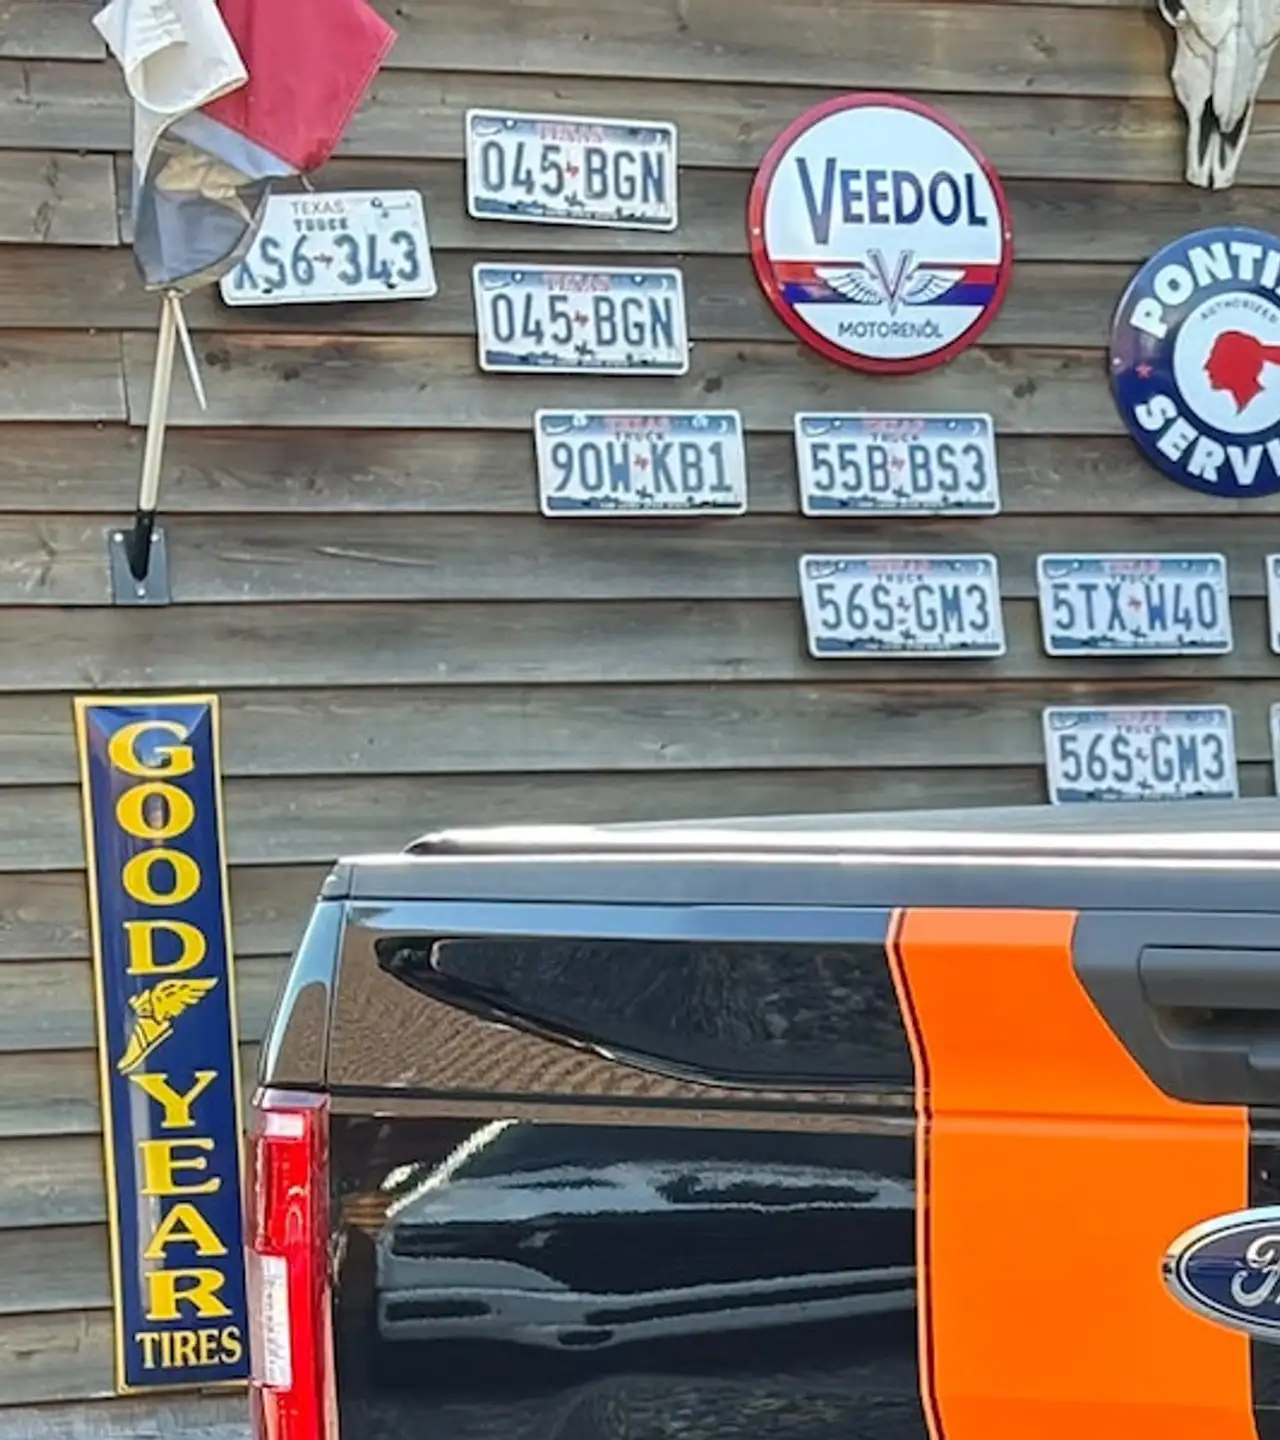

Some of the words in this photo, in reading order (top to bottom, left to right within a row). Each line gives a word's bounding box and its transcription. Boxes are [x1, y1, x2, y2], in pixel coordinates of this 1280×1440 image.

[291, 201, 344, 215] TEXAS
[795, 157, 987, 244] VEEDOL
[135, 1326, 242, 1369] TIRES
